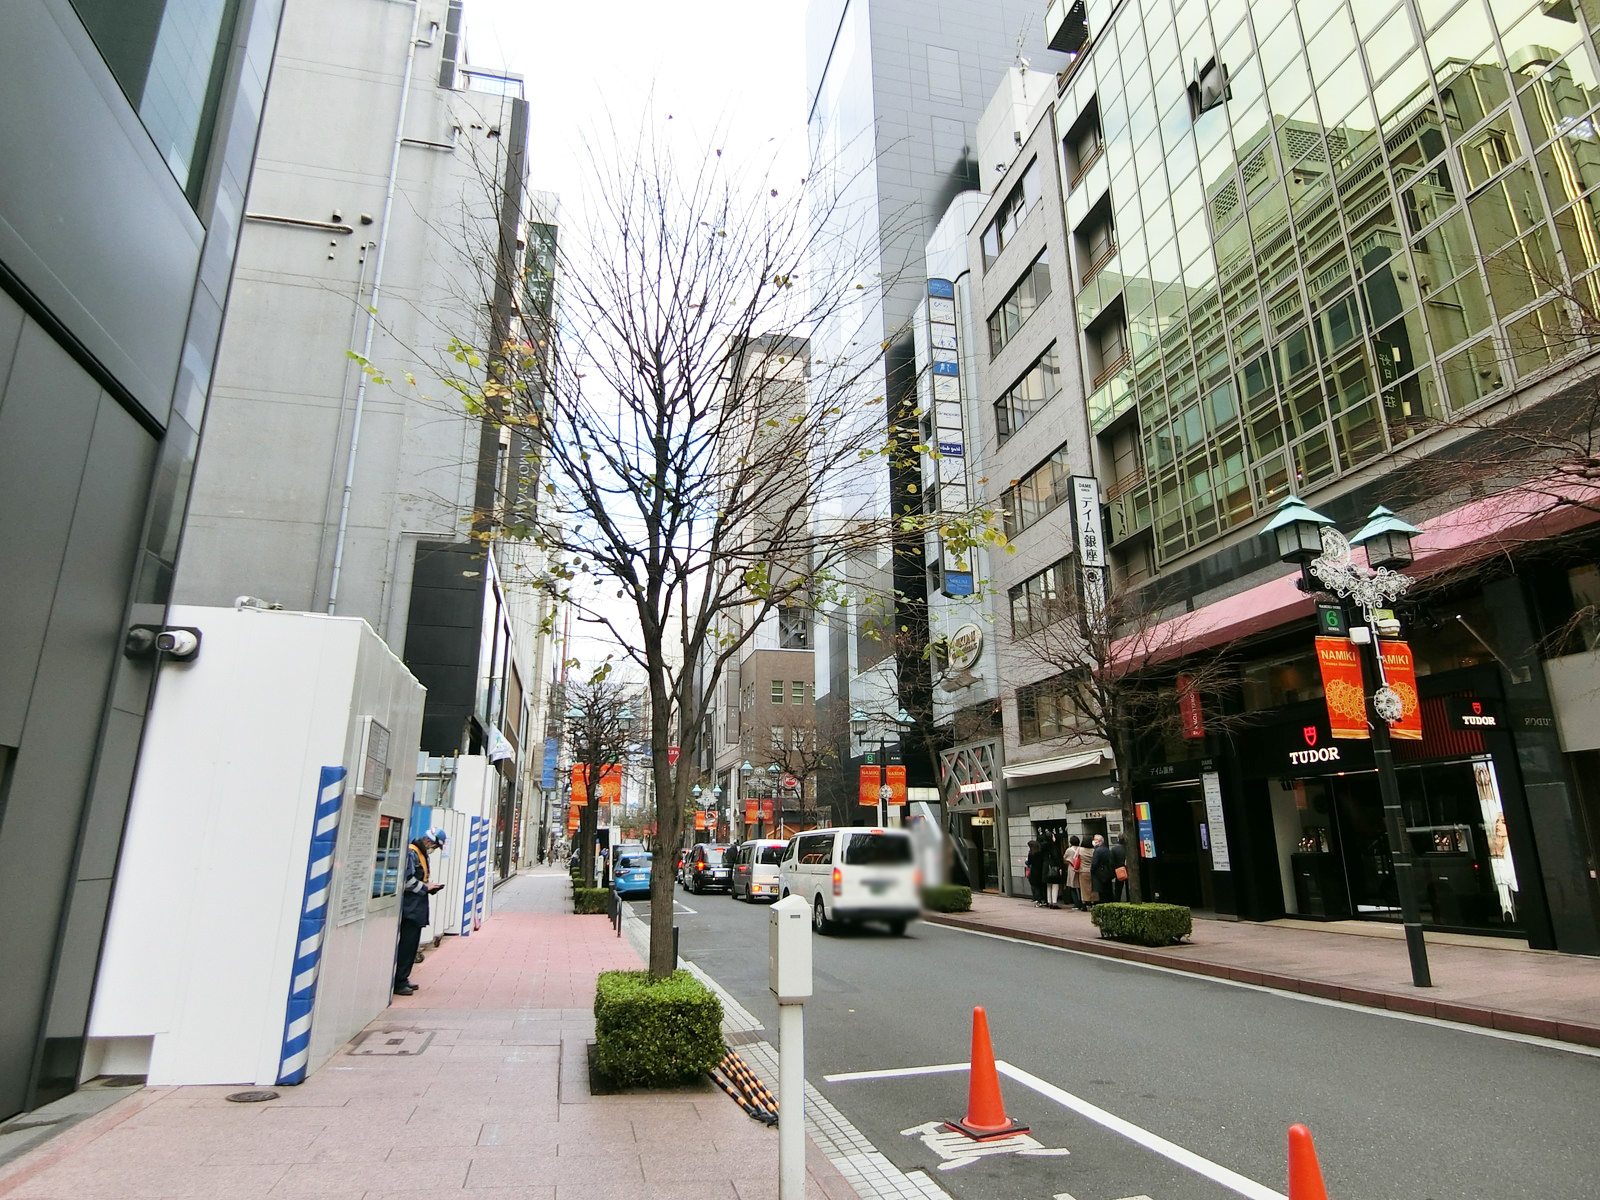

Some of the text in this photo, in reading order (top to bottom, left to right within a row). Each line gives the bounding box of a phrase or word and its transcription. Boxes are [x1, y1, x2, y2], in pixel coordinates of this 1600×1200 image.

[1326, 610, 1339, 627] 6
[1321, 650, 1356, 661] NAMIKI
[1382, 654, 1409, 665] AMIKI
[1462, 716, 1496, 726] TUDOR
[1289, 747, 1340, 765] TUDOR
